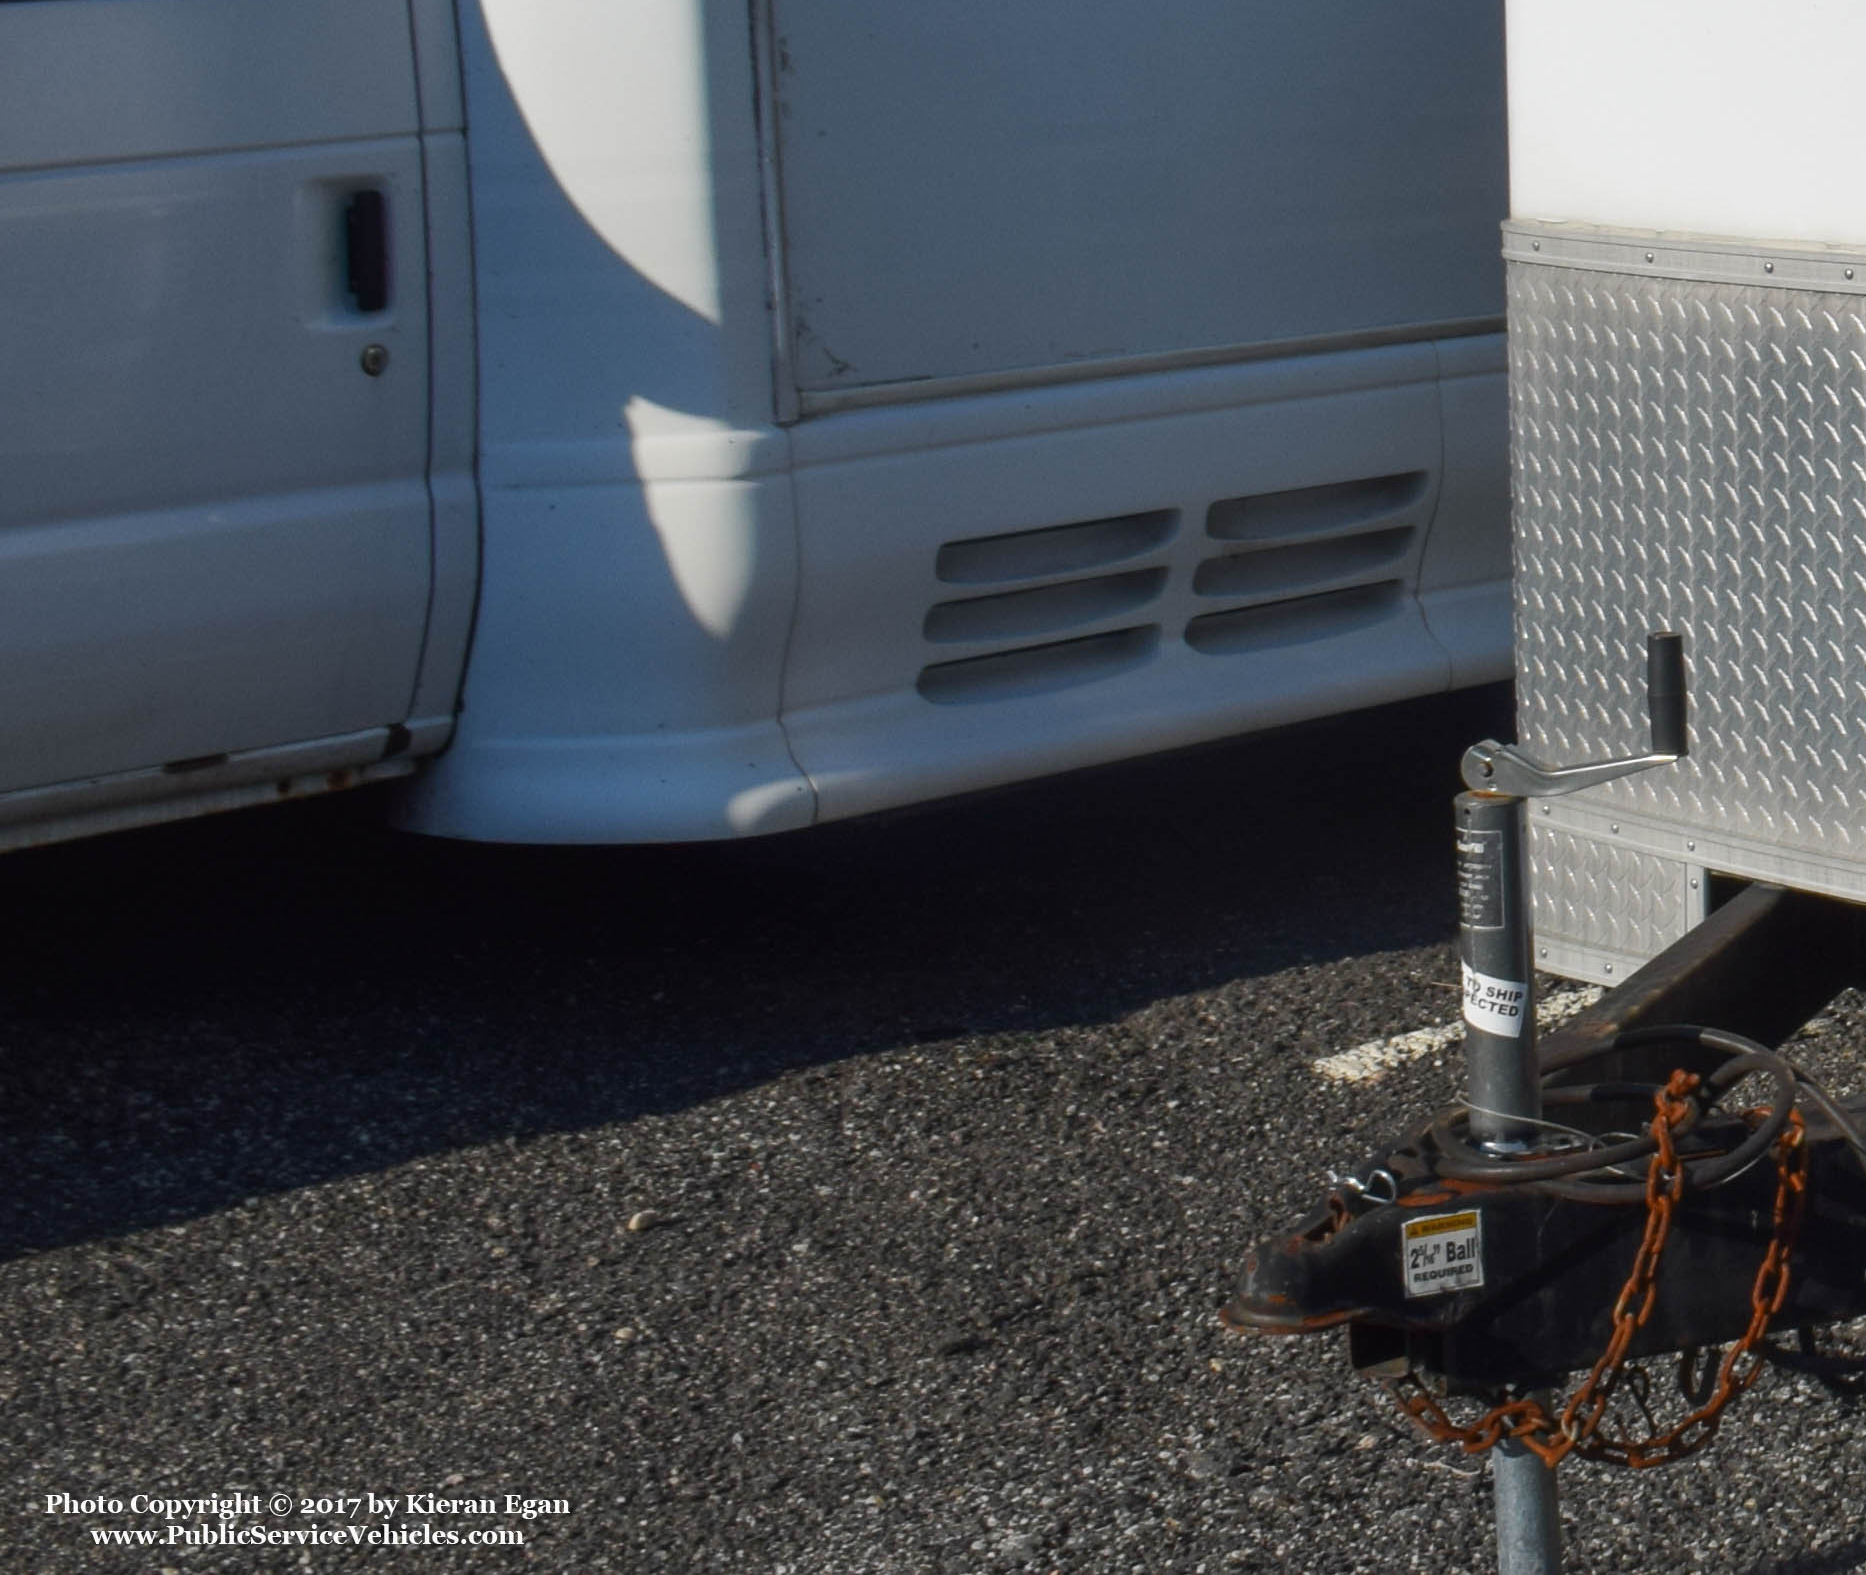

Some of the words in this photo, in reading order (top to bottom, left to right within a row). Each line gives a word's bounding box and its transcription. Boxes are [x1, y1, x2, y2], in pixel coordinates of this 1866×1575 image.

[1467, 976, 1481, 992] TO
[1486, 986, 1524, 1003] SHIP
[1446, 1237, 1476, 1263] Ball
[1413, 1263, 1474, 1283] REQUIRED
